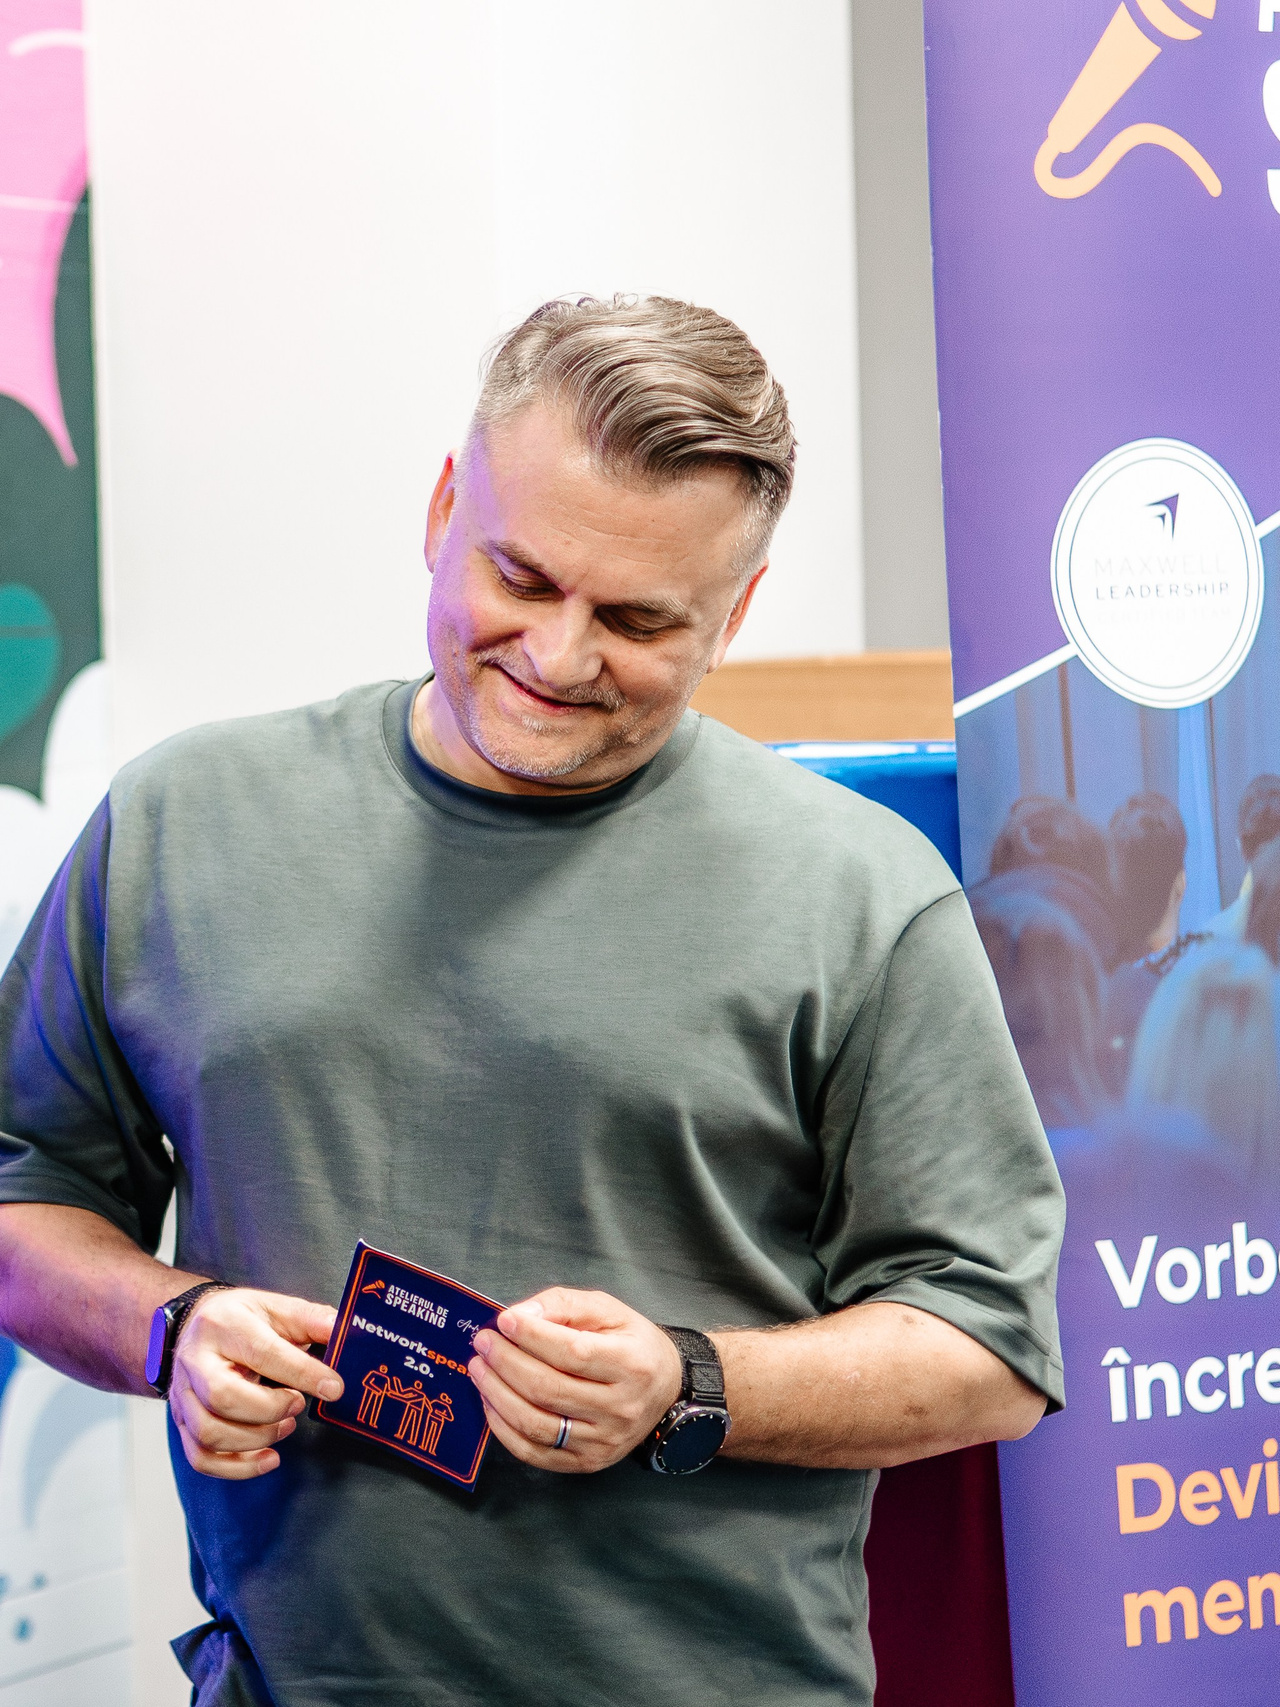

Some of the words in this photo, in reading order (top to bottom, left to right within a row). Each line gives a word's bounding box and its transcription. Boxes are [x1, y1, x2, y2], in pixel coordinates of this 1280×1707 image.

[1094, 554, 1229, 577] MAXWELL
[1095, 581, 1230, 601] LEADERSHIP
[1094, 1221, 1280, 1309] Vorb
[385, 1293, 447, 1329] SPEAKING
[388, 1284, 435, 1312] ATELIERUL
[436, 1305, 450, 1318] DE
[403, 1355, 435, 1378] 2.0.
